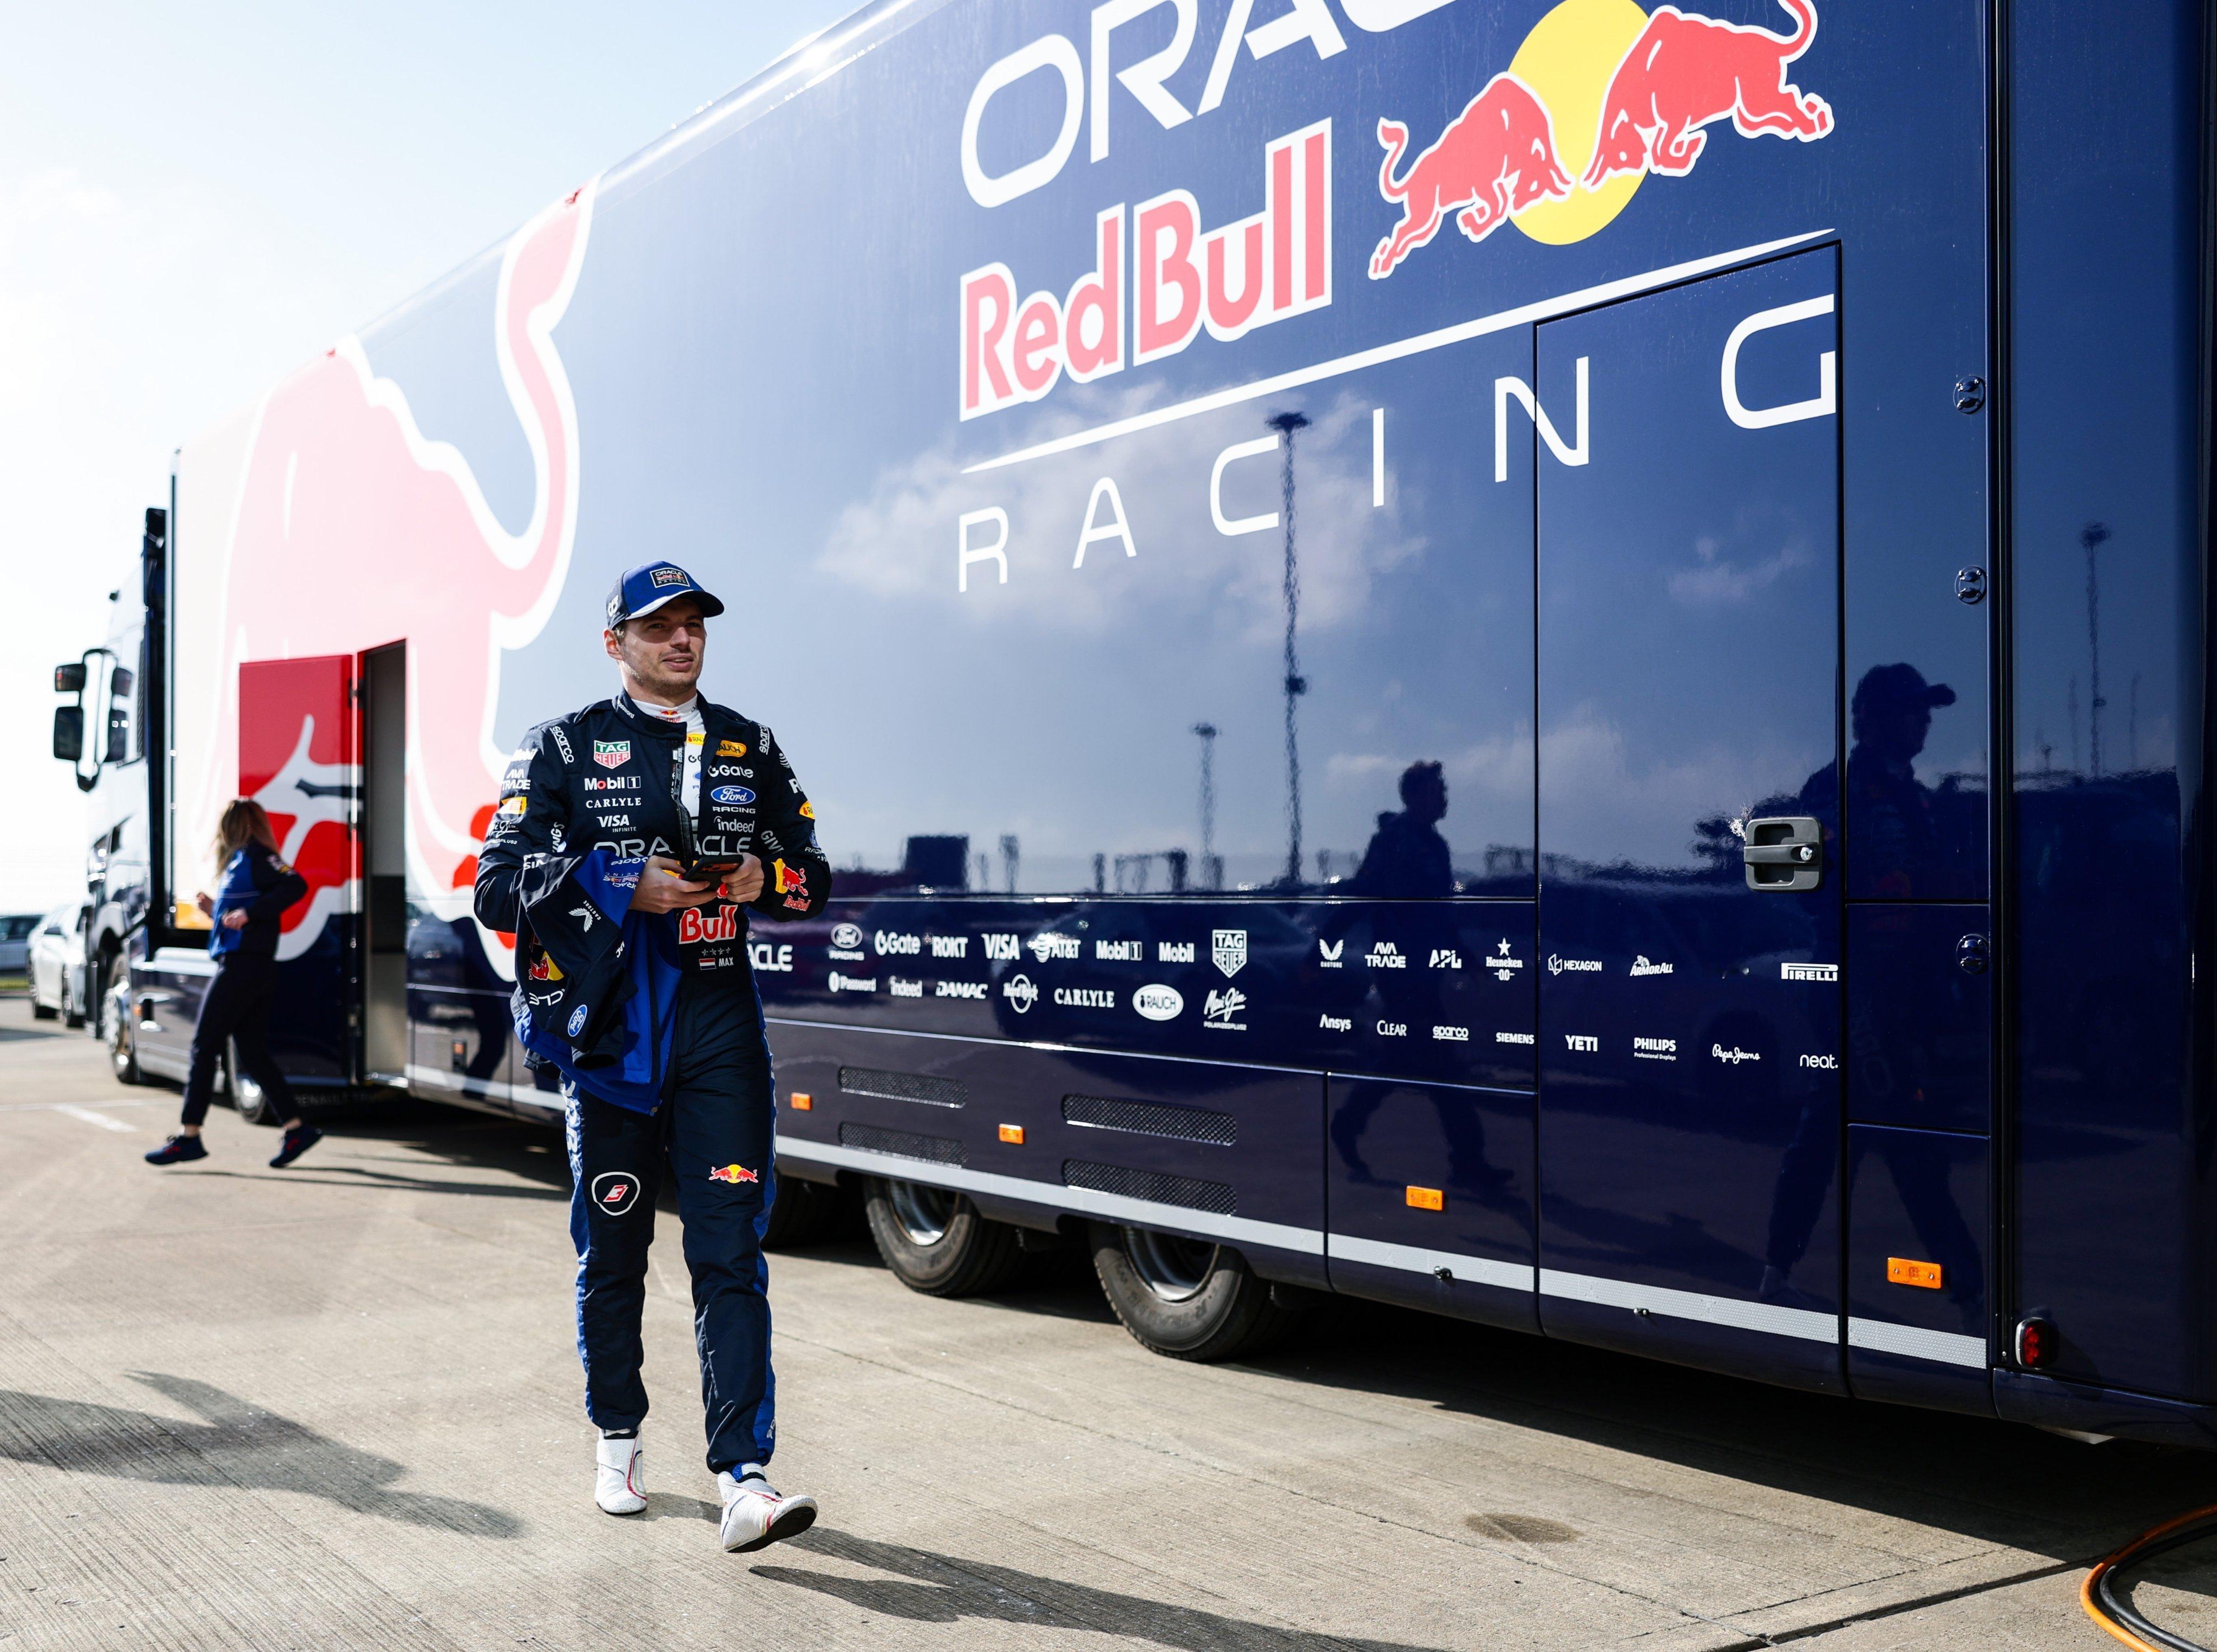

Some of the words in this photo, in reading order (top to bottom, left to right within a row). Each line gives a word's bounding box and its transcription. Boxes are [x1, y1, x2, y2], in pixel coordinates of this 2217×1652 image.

[961, 0, 1457, 208] ORA
[961, 202, 1125, 422] Red
[1133, 117, 1332, 366] Bull
[960, 293, 1836, 592] RACING
[549, 726, 574, 765] sparco
[758, 724, 770, 755] sparc
[597, 743, 627, 753] TAG
[717, 744, 741, 754] AUCH
[596, 753, 628, 767] HEUER
[506, 768, 524, 779] AVA
[719, 765, 754, 778] Gate
[502, 779, 531, 791] TRADE
[584, 777, 625, 791] Mobil
[720, 787, 747, 802] Ford
[585, 798, 642, 808] CARLYLE
[712, 806, 756, 814] RACING
[596, 814, 630, 828] VISA
[714, 817, 755, 833] indeed
[550, 821, 565, 853] INGS
[760, 830, 784, 854] GIV
[582, 900, 601, 920] CASTORE
[679, 904, 738, 945] Bull
[887, 931, 921, 955] Gate
[932, 936, 968, 958] ROKT
[981, 933, 1021, 960] VISA
[1051, 939, 1081, 959] AT&T
[1215, 933, 1244, 949] TAG
[1373, 942, 1398, 955] AVA
[1096, 940, 1129, 961] Mobil
[1158, 942, 1195, 963] Mobil
[718, 957, 734, 967] MAX
[1215, 951, 1245, 974] HEUER
[1364, 955, 1407, 969] TRADE
[1485, 956, 1524, 969] Heineken
[1563, 959, 1602, 972] HEXAGON
[1781, 962, 1839, 982] PIRELLI
[889, 976, 923, 998] indeed
[935, 980, 988, 999] DAMAC
[1054, 988, 1115, 1009] CARLYLE
[1147, 996, 1177, 1010] RAUCH
[569, 1010, 585, 1032] Ford
[1319, 1013, 1352, 1032] Ansys
[1432, 1025, 1469, 1041] sparco
[1496, 1031, 1535, 1045] SIEMENS
[1565, 1035, 1598, 1052] YETI
[1634, 1037, 1677, 1052] PHILIPS
[1659, 1054, 1677, 1062] Displays
[1712, 1043, 1734, 1063] Pepe
[1731, 1047, 1761, 1064] Jeans
[1800, 1054, 1839, 1069] neat.
